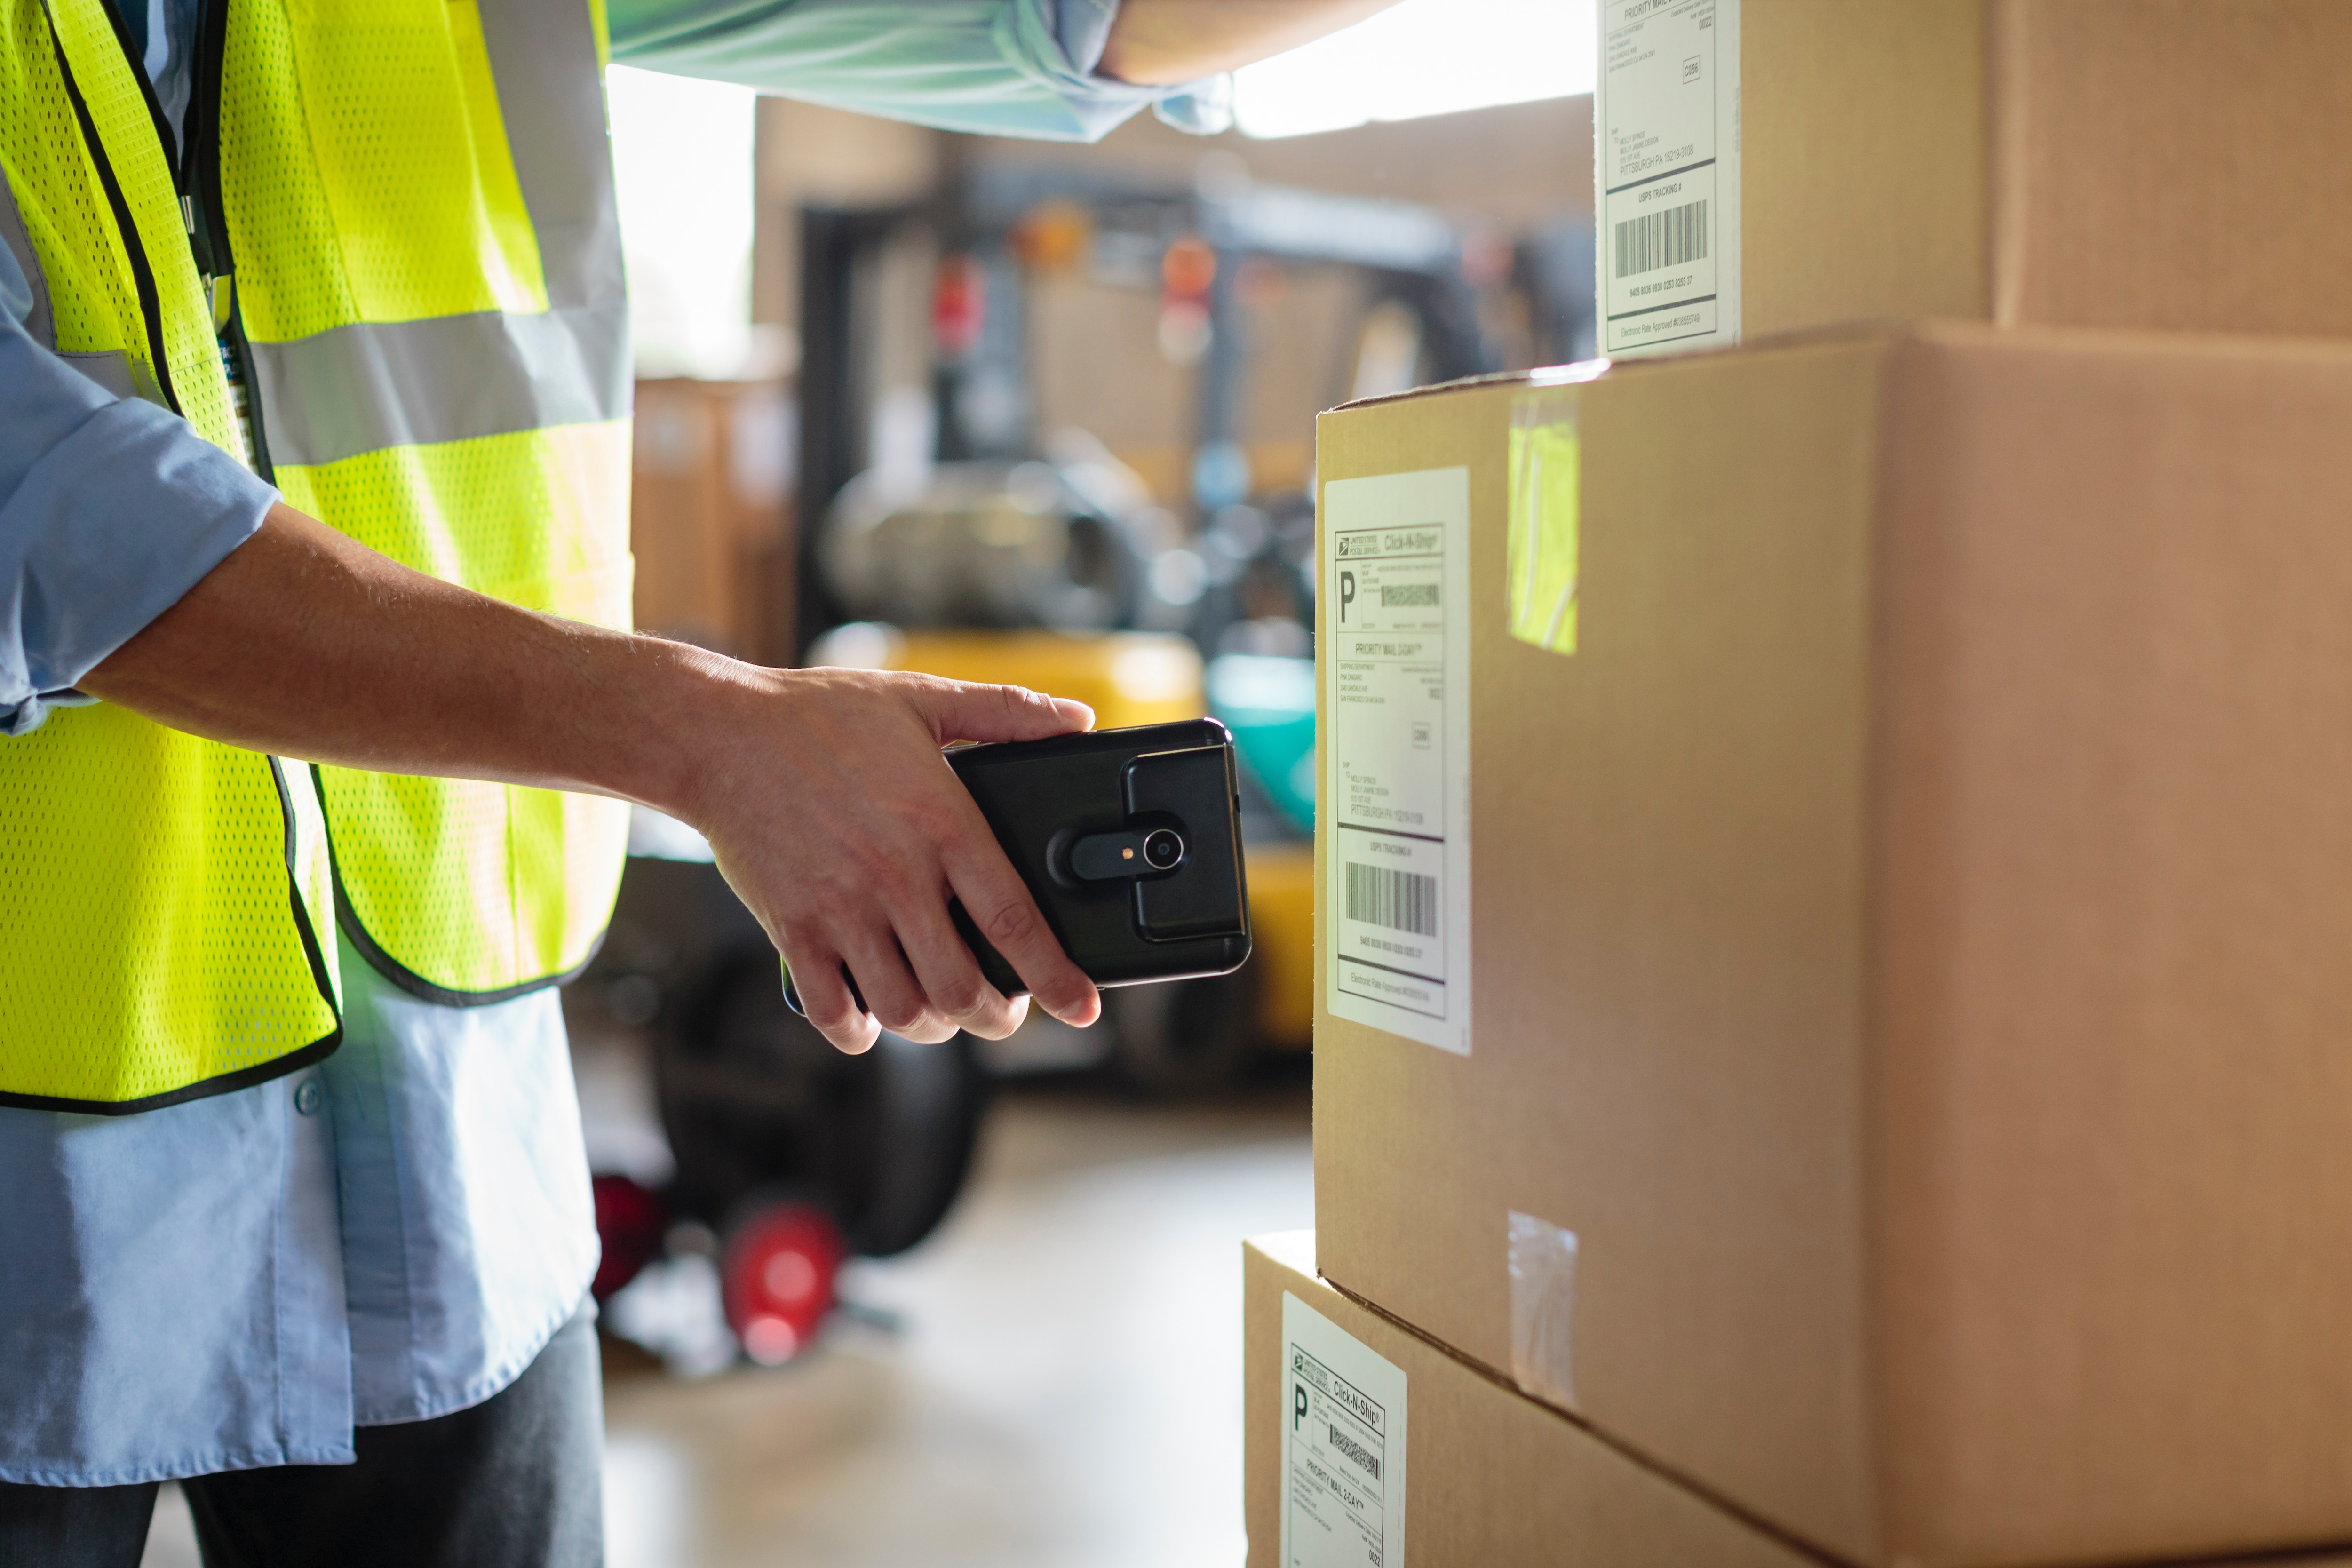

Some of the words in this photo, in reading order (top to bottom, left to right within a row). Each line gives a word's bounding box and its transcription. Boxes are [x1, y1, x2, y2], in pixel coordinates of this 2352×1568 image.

[1624, 0, 1650, 21] PRIORITY
[1699, 16, 1711, 31] 0022
[1685, 62, 1698, 76] C056
[1645, 135, 1658, 146] DESIGN
[1620, 156, 1653, 176] PITTSBURGH
[1655, 153, 1662, 166] PA
[1664, 143, 1693, 163] 15219-3108
[1638, 191, 1651, 203] USPS
[1653, 183, 1677, 199] TRACKING
[1678, 182, 1681, 191] #
[1663, 279, 1674, 290] 0253
[1675, 276, 1685, 287] 8253
[1687, 275, 1692, 285] 37
[1621, 325, 1640, 337] Electronic
[1641, 323, 1651, 333] Rate
[1652, 318, 1672, 333] Approved
[1341, 571, 1355, 622] P
[1356, 643, 1381, 655] PRIORITY
[1383, 644, 1396, 655] MAIL
[1351, 804, 1383, 819] PITTSBURGH
[1370, 841, 1381, 852] USPS
[1383, 843, 1406, 856] TRACKING
[1351, 972, 1370, 986] Electronic
[1371, 978, 1381, 989] Rate
[1295, 1383, 1307, 1431] P
[1307, 1459, 1329, 1486] PRIORITY
[1330, 1477, 1343, 1496] MAIL
[1369, 1549, 1380, 1567] 0022
